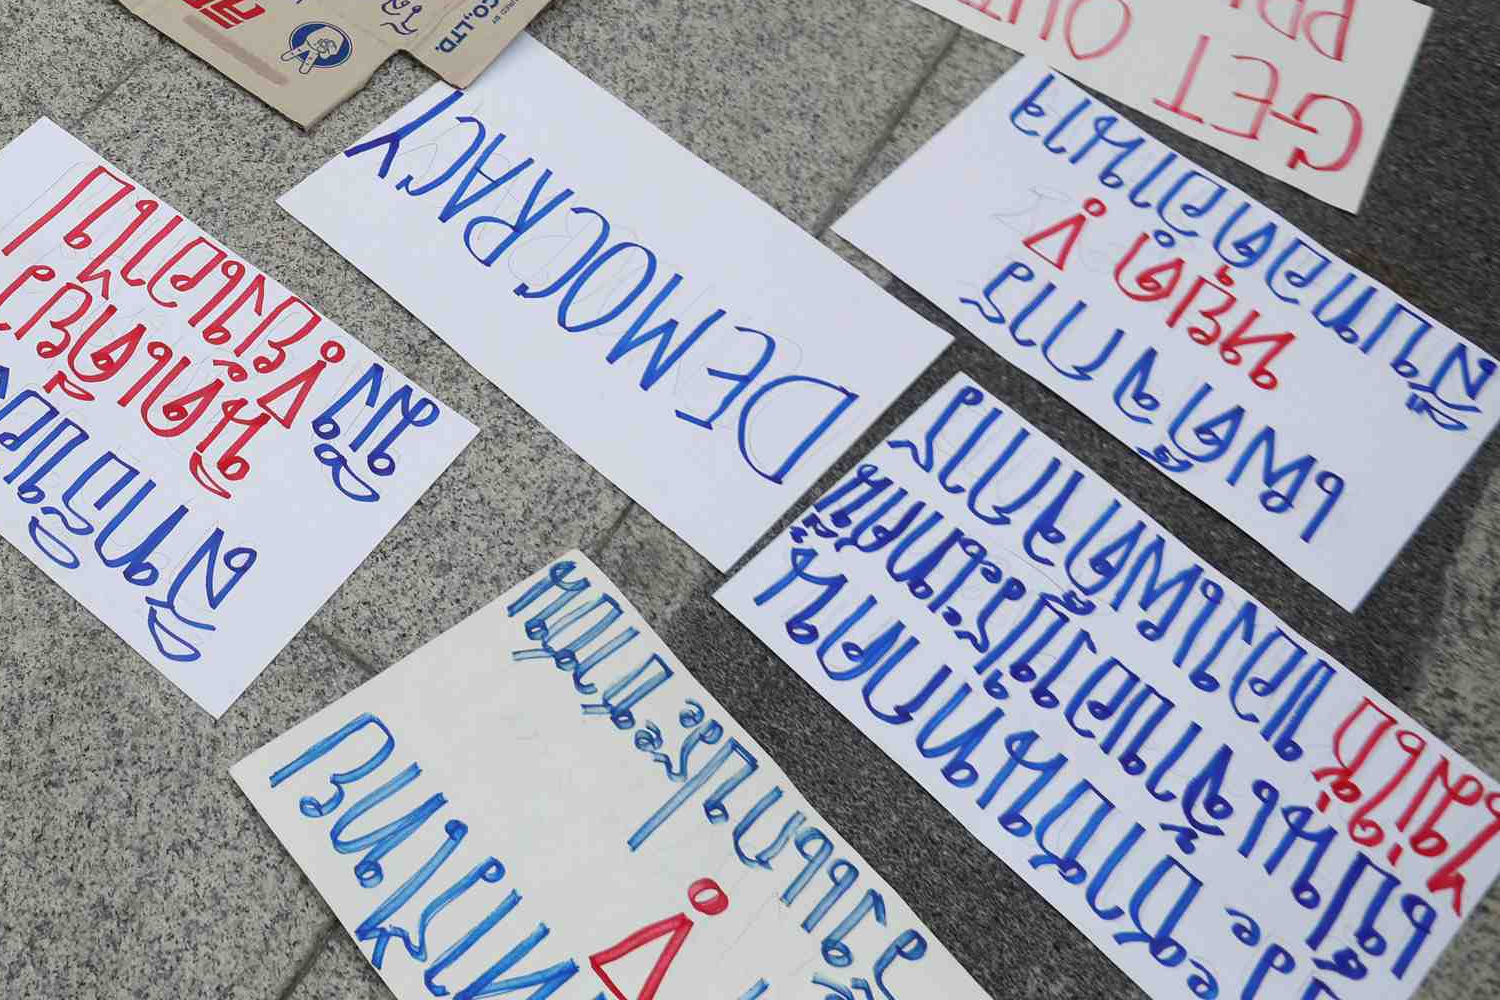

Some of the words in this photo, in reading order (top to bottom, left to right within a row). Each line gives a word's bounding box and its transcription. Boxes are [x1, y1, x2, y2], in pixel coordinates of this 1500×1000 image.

[1009, 73, 1498, 432] สืบทอดอำนาจ
[1152, 34, 1364, 173] GET
[342, 89, 857, 485] DEMOCRACY
[958, 261, 1346, 544] เผด็จการ
[269, 712, 612, 1000] หารไทย
[753, 538, 1342, 999] ะชาชนทุกคน
[787, 464, 1439, 982] เป็นเจ้าของประเทศนี้
